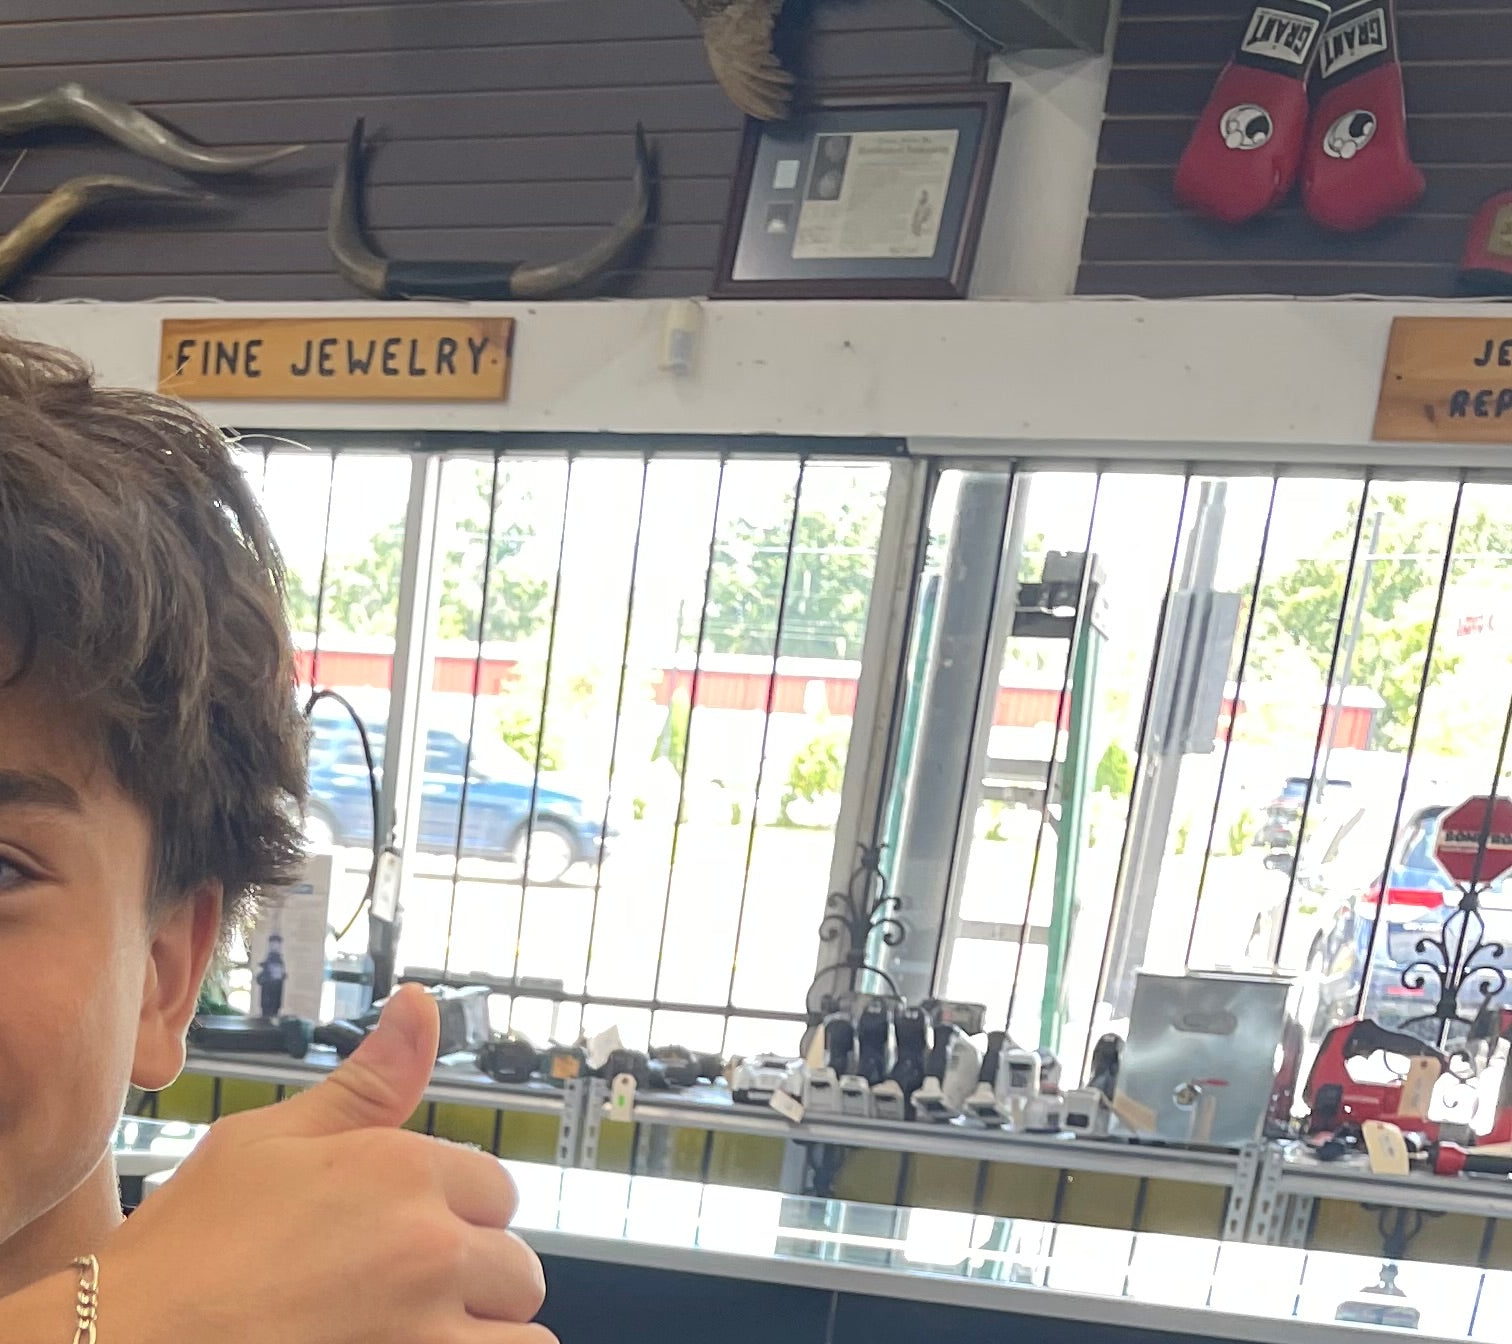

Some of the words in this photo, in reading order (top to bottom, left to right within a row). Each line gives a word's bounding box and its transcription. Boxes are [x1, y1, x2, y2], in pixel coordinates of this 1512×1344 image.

[1245, 14, 1314, 58] GRANT
[175, 338, 263, 378] FINE
[290, 337, 491, 377] JEWELRY
